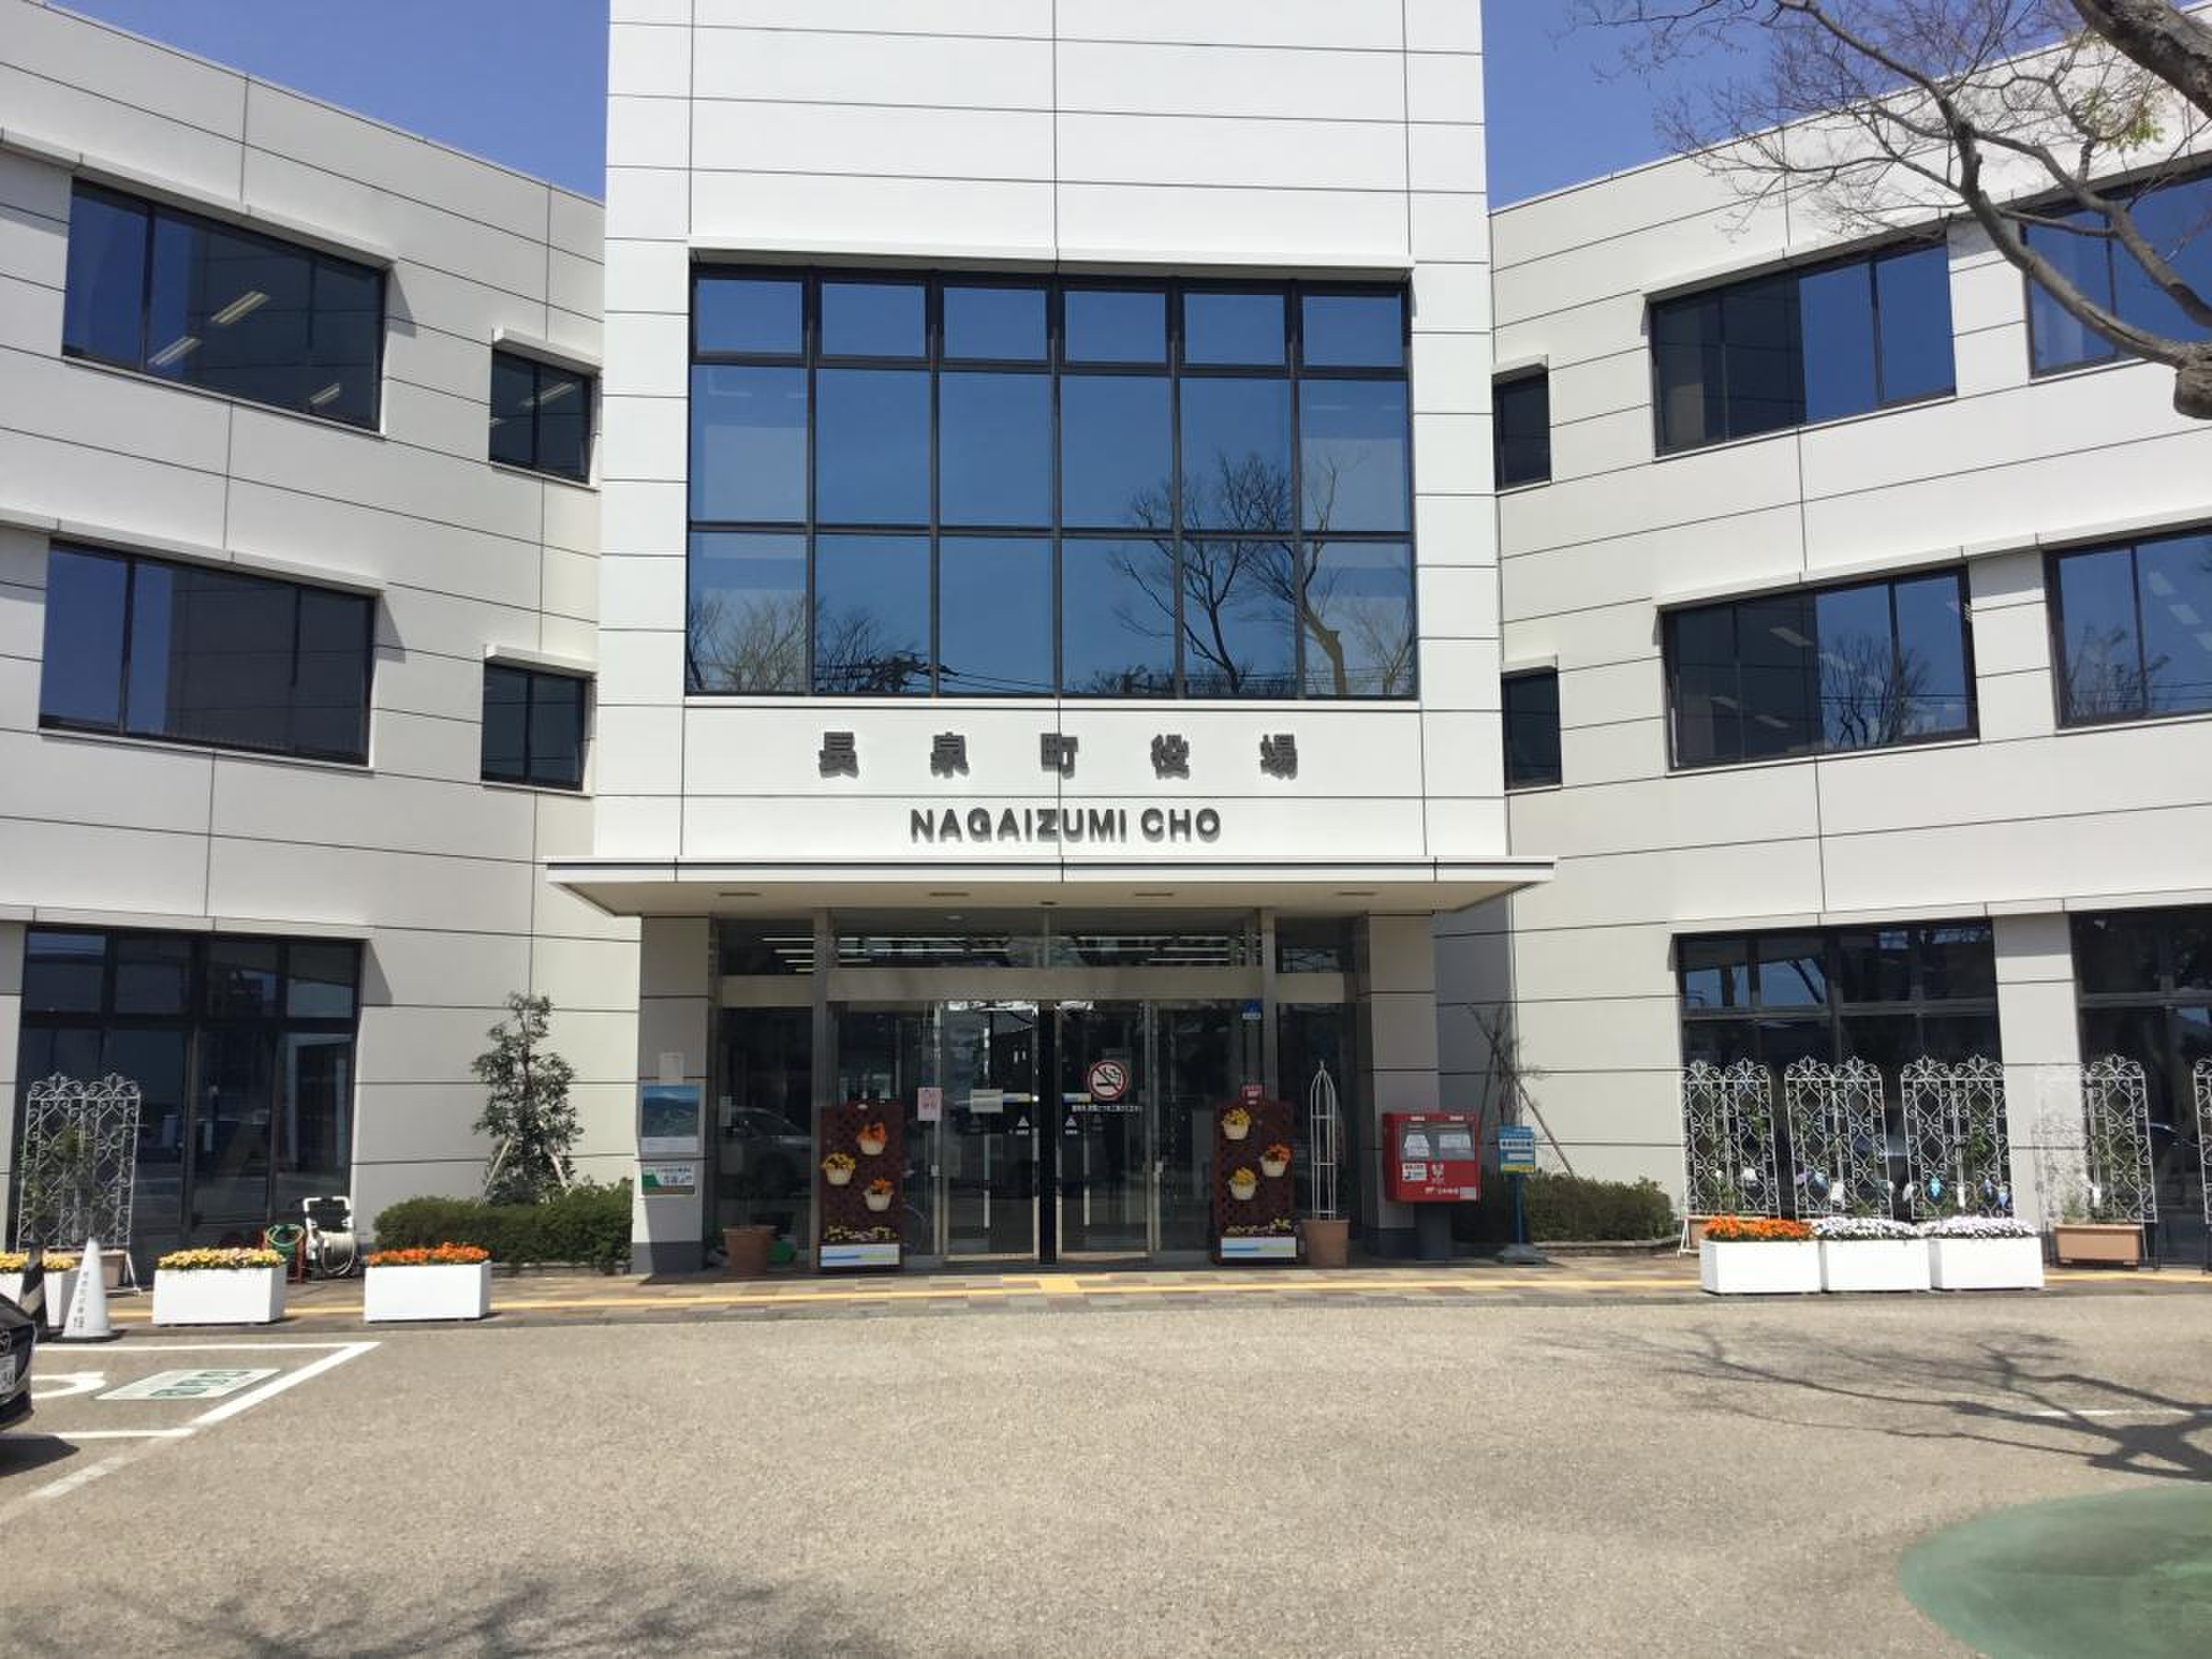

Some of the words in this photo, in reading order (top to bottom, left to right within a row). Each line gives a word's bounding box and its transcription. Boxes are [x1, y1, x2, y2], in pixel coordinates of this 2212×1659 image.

[818, 731, 1298, 777] 長泉町役場
[910, 807, 1125, 841] NAGAIZUMI
[1141, 807, 1220, 841] CHO
